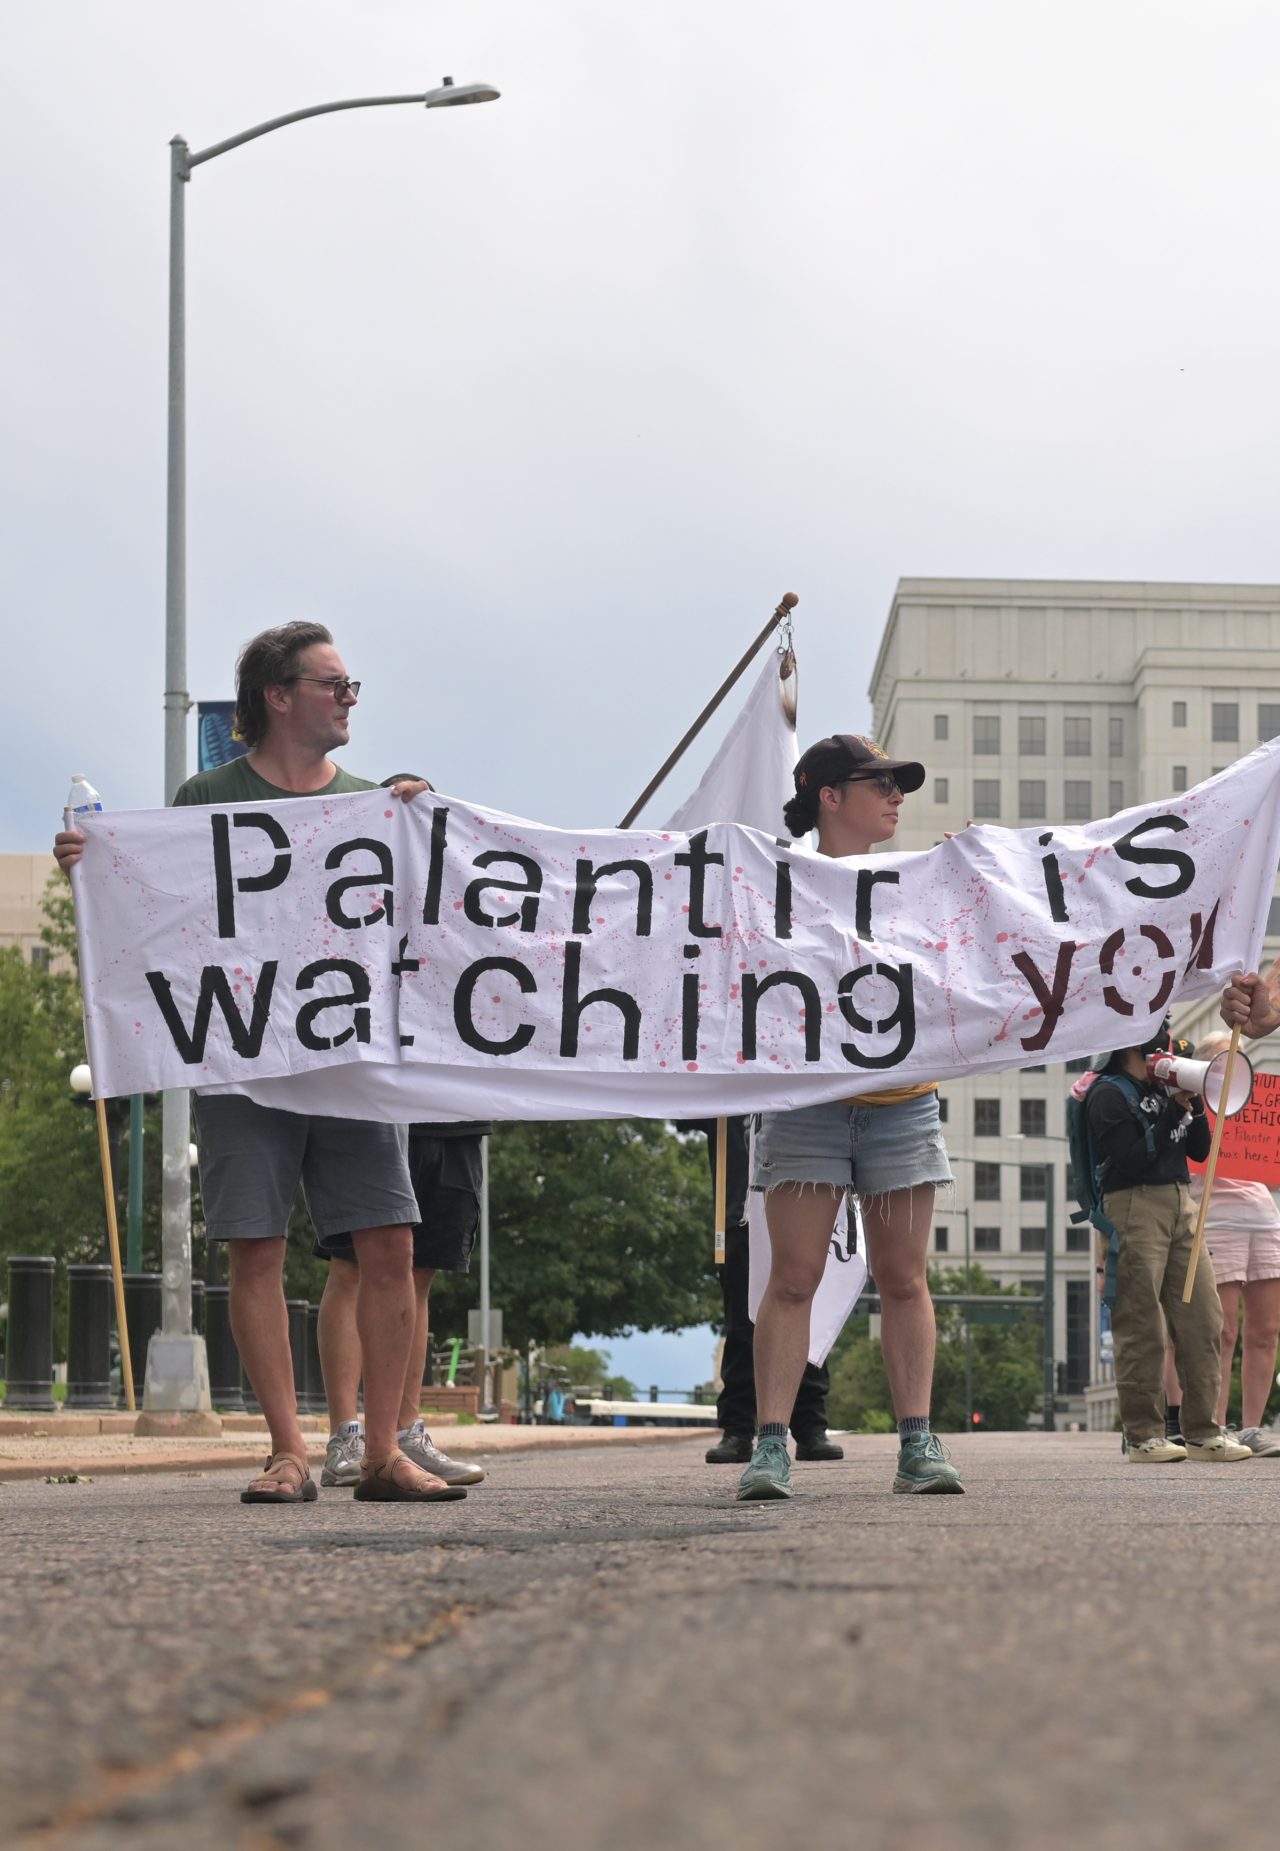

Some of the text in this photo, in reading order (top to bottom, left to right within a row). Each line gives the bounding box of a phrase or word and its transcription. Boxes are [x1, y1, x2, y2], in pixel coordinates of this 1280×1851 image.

[211, 807, 1196, 942] Palantir is
[1178, 1039, 1188, 1050] P
